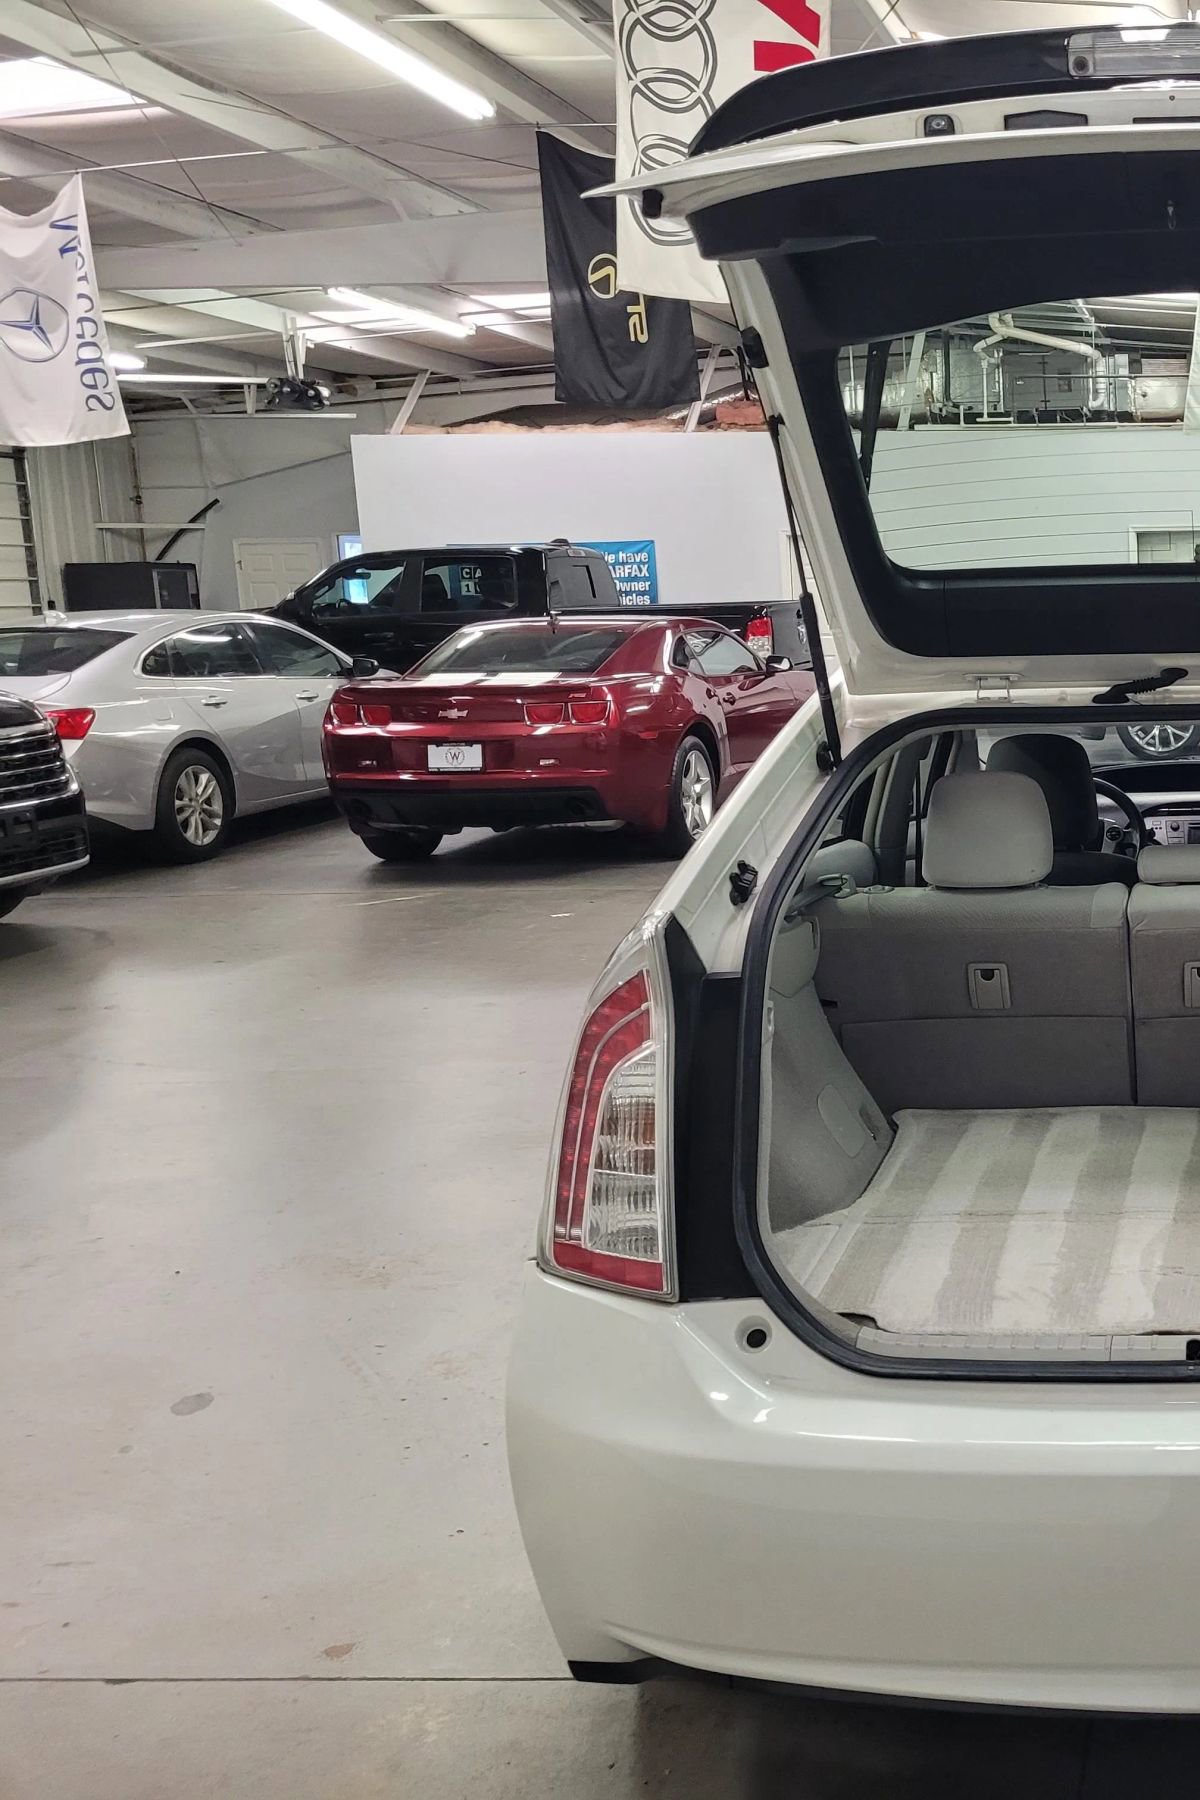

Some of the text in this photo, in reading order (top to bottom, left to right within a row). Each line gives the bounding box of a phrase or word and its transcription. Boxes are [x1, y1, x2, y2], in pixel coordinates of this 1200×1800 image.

[619, 551, 649, 563] have
[608, 564, 650, 578] RFAX
[619, 593, 651, 606] icles
